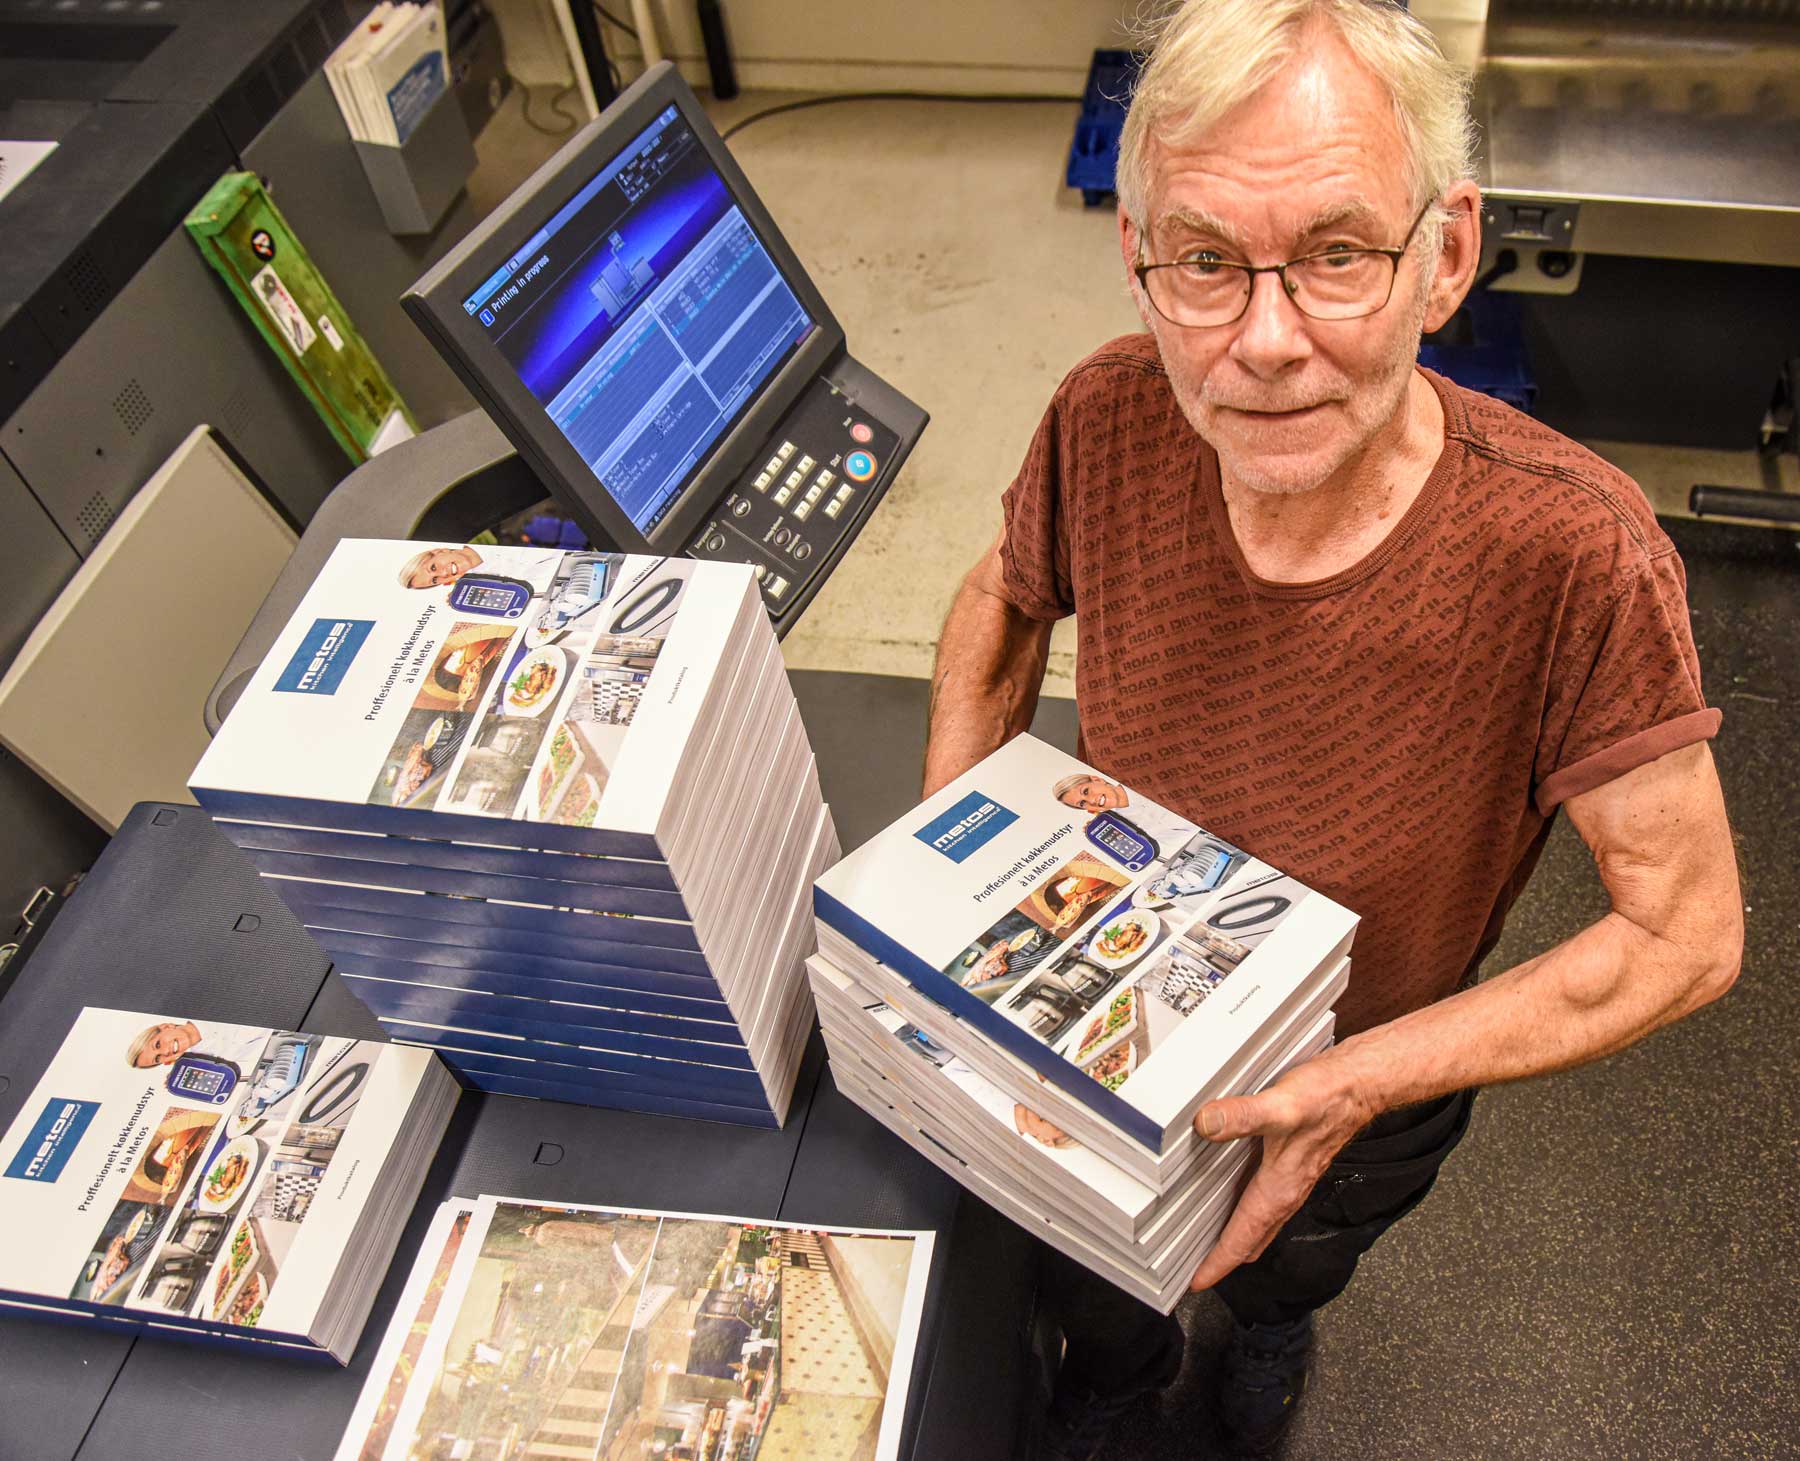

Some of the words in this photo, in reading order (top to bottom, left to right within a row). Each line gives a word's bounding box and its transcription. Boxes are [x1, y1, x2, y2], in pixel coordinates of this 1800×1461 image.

[491, 285, 519, 312] Printing
[525, 255, 550, 282] progress
[1127, 623, 1166, 645] ROAD
[1168, 608, 1220, 630] DEVIL
[1133, 596, 1170, 618] ROAD
[297, 623, 346, 690] metos
[364, 660, 404, 721] Proffesionelt
[401, 604, 437, 661] køkkenudstyr
[407, 667, 420, 679] la
[412, 640, 435, 667] Metos
[1118, 675, 1158, 696] ROAD
[1161, 660, 1211, 683] DEVIL
[1206, 637, 1261, 661] ROAD
[1121, 651, 1161, 672] ROAD
[1163, 635, 1214, 658] DEVIL
[668, 665, 688, 704] Produktkatalog
[1114, 701, 1156, 721] ROAD
[1160, 686, 1210, 708] DEVIL
[1203, 664, 1257, 687] ROAD
[1111, 726, 1154, 746] ROAD
[1157, 711, 1206, 732] DEVIL
[1202, 689, 1255, 713] ROAD
[1156, 735, 1207, 757] DEVIL
[1201, 713, 1252, 737] ROAD
[1200, 738, 1250, 761] ROAD
[1255, 716, 1311, 743] DEVIL
[1199, 761, 1249, 783] ROAD
[1254, 740, 1308, 767] DEVIL
[1198, 785, 1248, 807] ROAD
[1251, 766, 1304, 791] DEVIL
[1250, 791, 1301, 815] DEVIL
[932, 802, 996, 849] metos
[973, 861, 1024, 903] Proffesionelt
[1022, 822, 1074, 865] køkkenudstyr
[1027, 872, 1037, 883] la
[1034, 855, 1059, 877] Metos
[1229, 984, 1261, 1015] Produktkatalog
[25, 1103, 76, 1177] metos
[78, 1150, 119, 1211] Proffesionelt
[114, 1085, 156, 1153] køkkenudstyr
[121, 1156, 133, 1168] la
[128, 1126, 149, 1155] Metos
[338, 1159, 360, 1200] Produktkatalog
